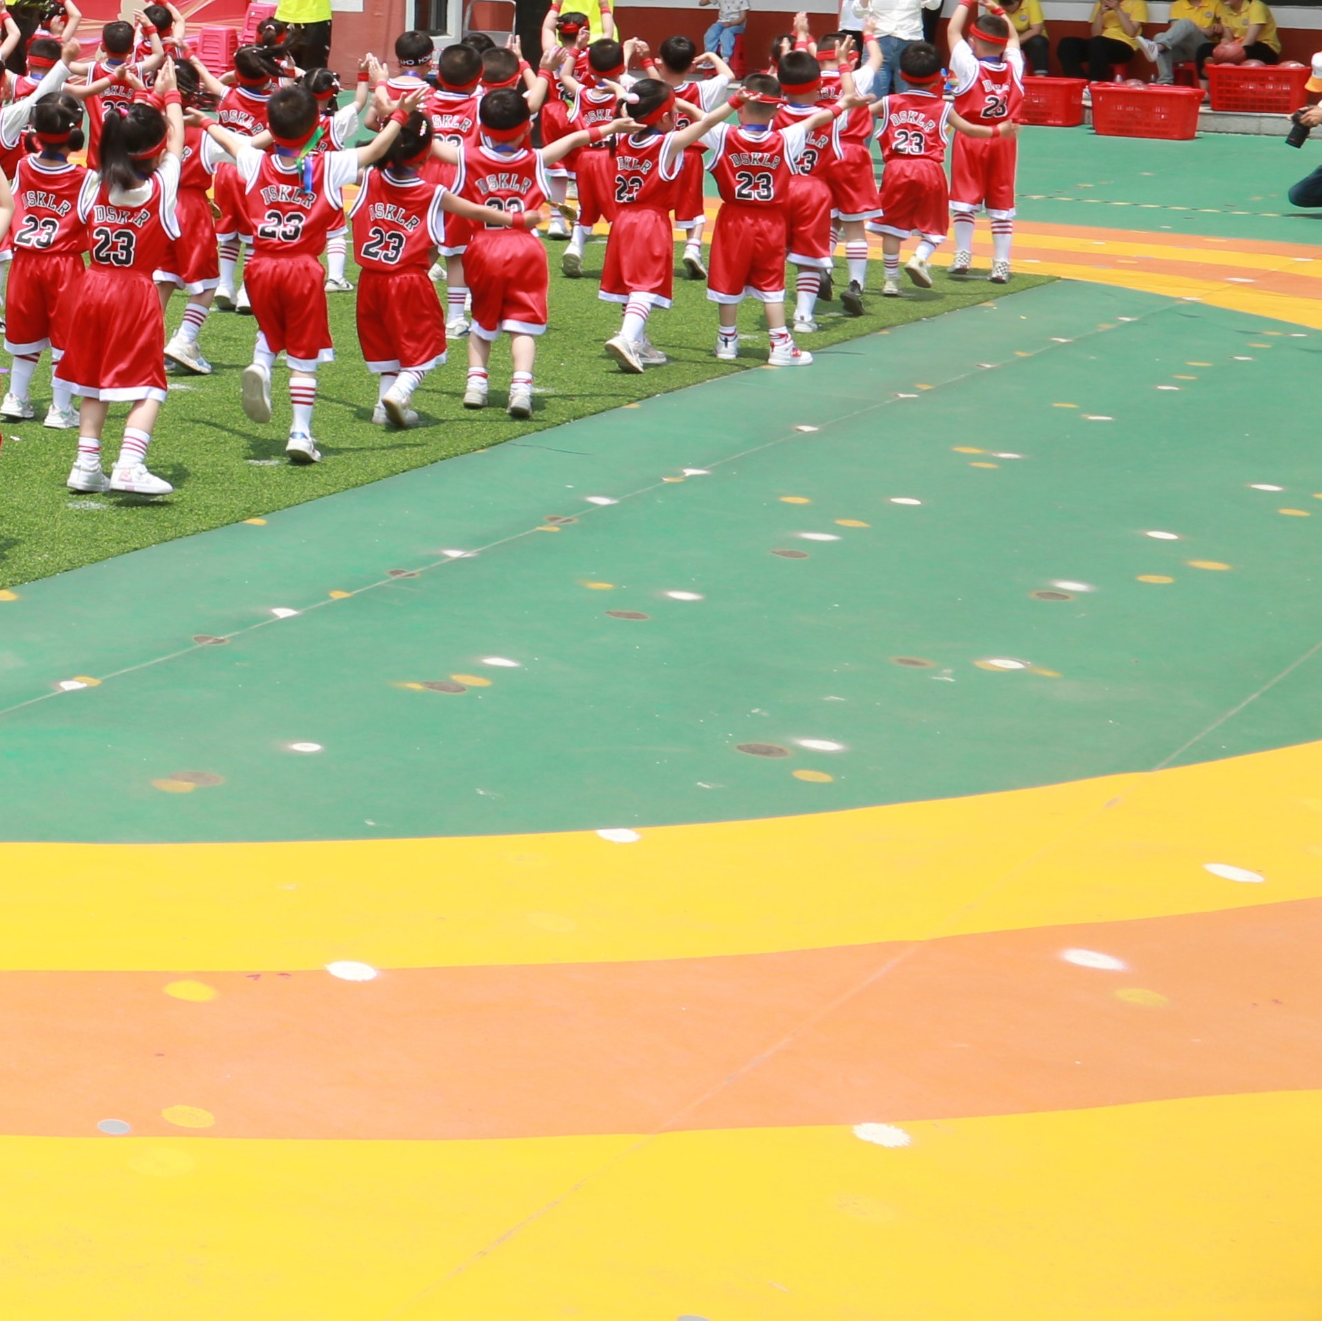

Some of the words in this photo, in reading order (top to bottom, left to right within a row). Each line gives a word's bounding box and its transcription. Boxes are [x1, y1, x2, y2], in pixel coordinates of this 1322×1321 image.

[430, 114, 472, 132] SKLR
[890, 110, 936, 132] DSKLR
[892, 129, 925, 155] 23
[731, 151, 780, 169] DSKLR
[475, 172, 532, 195] DSKLR
[735, 171, 775, 202] 23
[94, 204, 151, 229] DSKR
[258, 208, 306, 242] 23
[13, 214, 60, 249] 23
[92, 226, 136, 268] 23
[361, 226, 407, 264] 23
